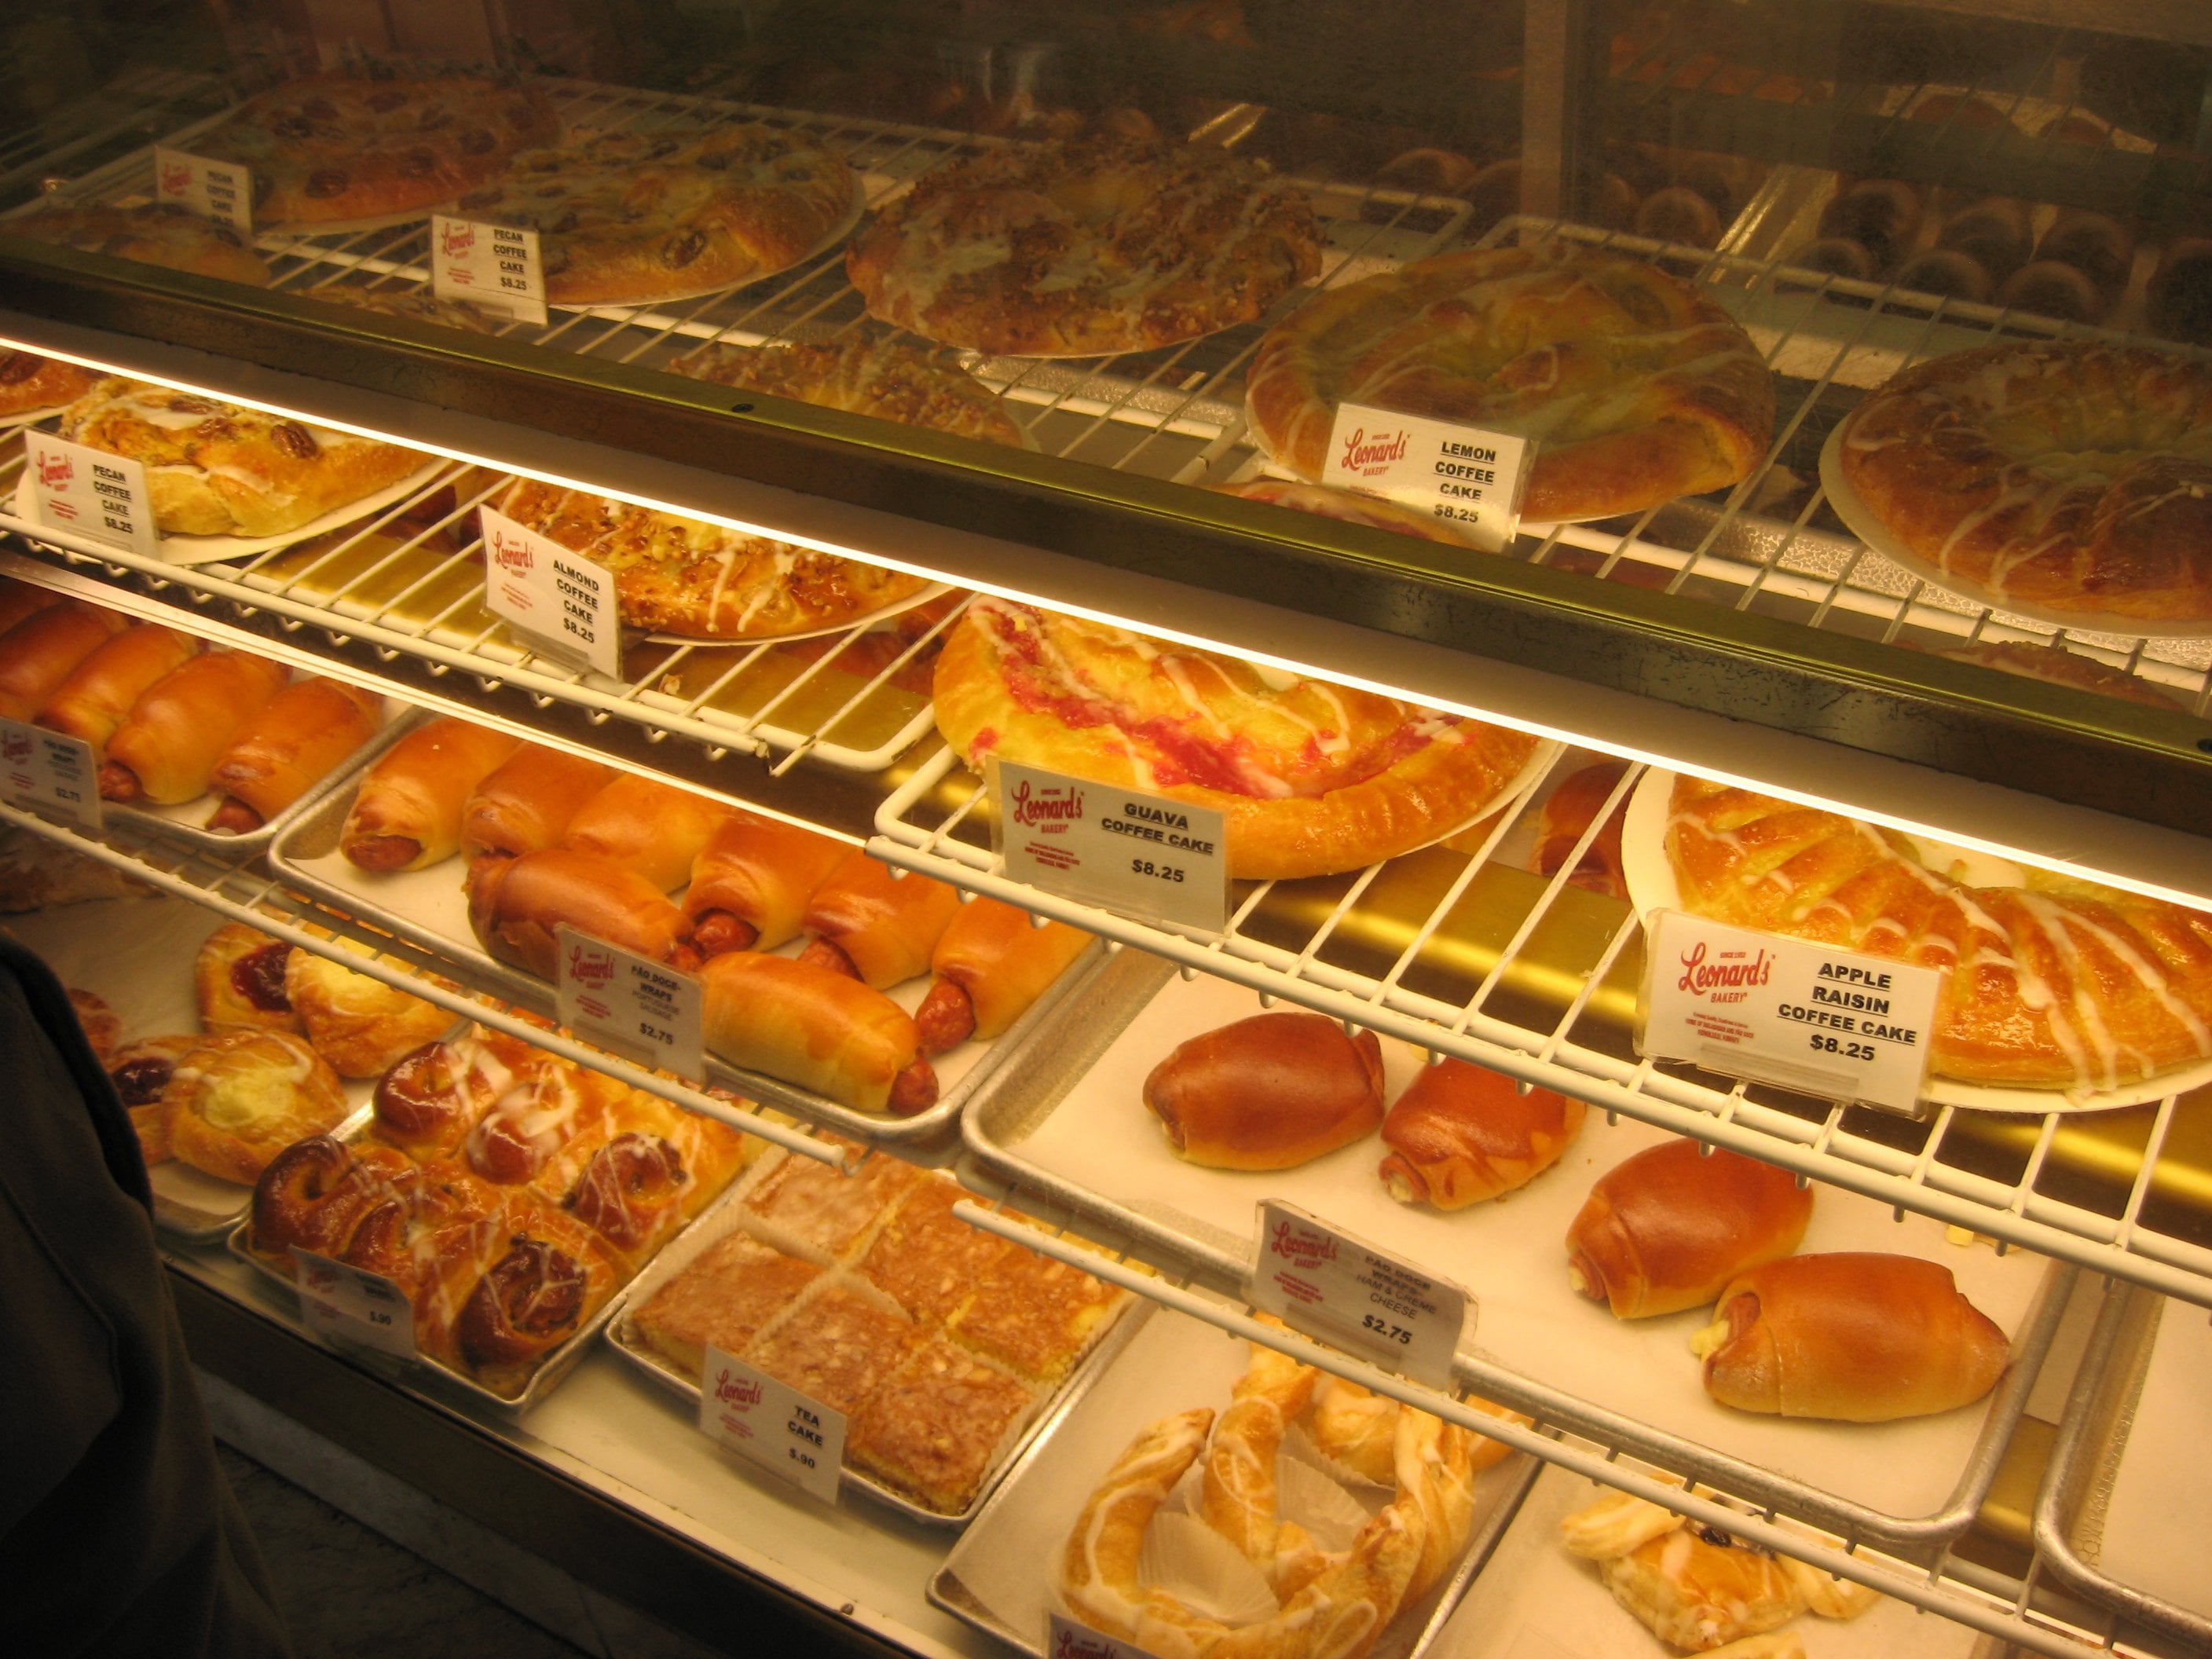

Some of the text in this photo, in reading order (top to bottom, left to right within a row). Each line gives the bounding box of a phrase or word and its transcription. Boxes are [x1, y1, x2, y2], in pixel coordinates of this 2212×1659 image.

[493, 229, 523, 242] PECAN
[493, 244, 527, 258] COFFEE
[500, 261, 525, 273] CAKE
[500, 276, 526, 290] $8.25
[1441, 441, 1496, 462] LEMON
[93, 464, 126, 482] PECAN
[1434, 461, 1496, 482] COFFEE
[93, 481, 131, 500] COFFEE
[1440, 483, 1482, 500] CAKE
[101, 500, 130, 516] CAKE
[1434, 504, 1478, 523] $8.25
[104, 516, 134, 534] $8.25
[553, 559, 599, 591] ALMOND
[556, 578, 599, 610] COFFEE
[563, 599, 593, 624] CAKE
[563, 617, 595, 644] $8.25
[1124, 803, 1188, 829] GUAVA
[1101, 818, 1214, 855] COFFEE CAKE
[1132, 859, 1185, 883] $8.25
[1818, 963, 1892, 989] APPLE
[640, 983, 672, 1002] WRAPS
[1711, 992, 1745, 1003] BAKERY
[1811, 986, 1890, 1013] RAISIN
[639, 1023, 674, 1045] $2.75
[1778, 1004, 1855, 1031] COFFEE
[1861, 1020, 1917, 1043] CAKE
[1810, 1034, 1875, 1061] $8.25
[1357, 1273, 1382, 1291] HAM
[1370, 1292, 1417, 1320] CHEESE
[1362, 1314, 1412, 1345] $2.75
[795, 1404, 820, 1426] TEA
[788, 1420, 822, 1446] CAKE
[789, 1448, 815, 1469] $.90
